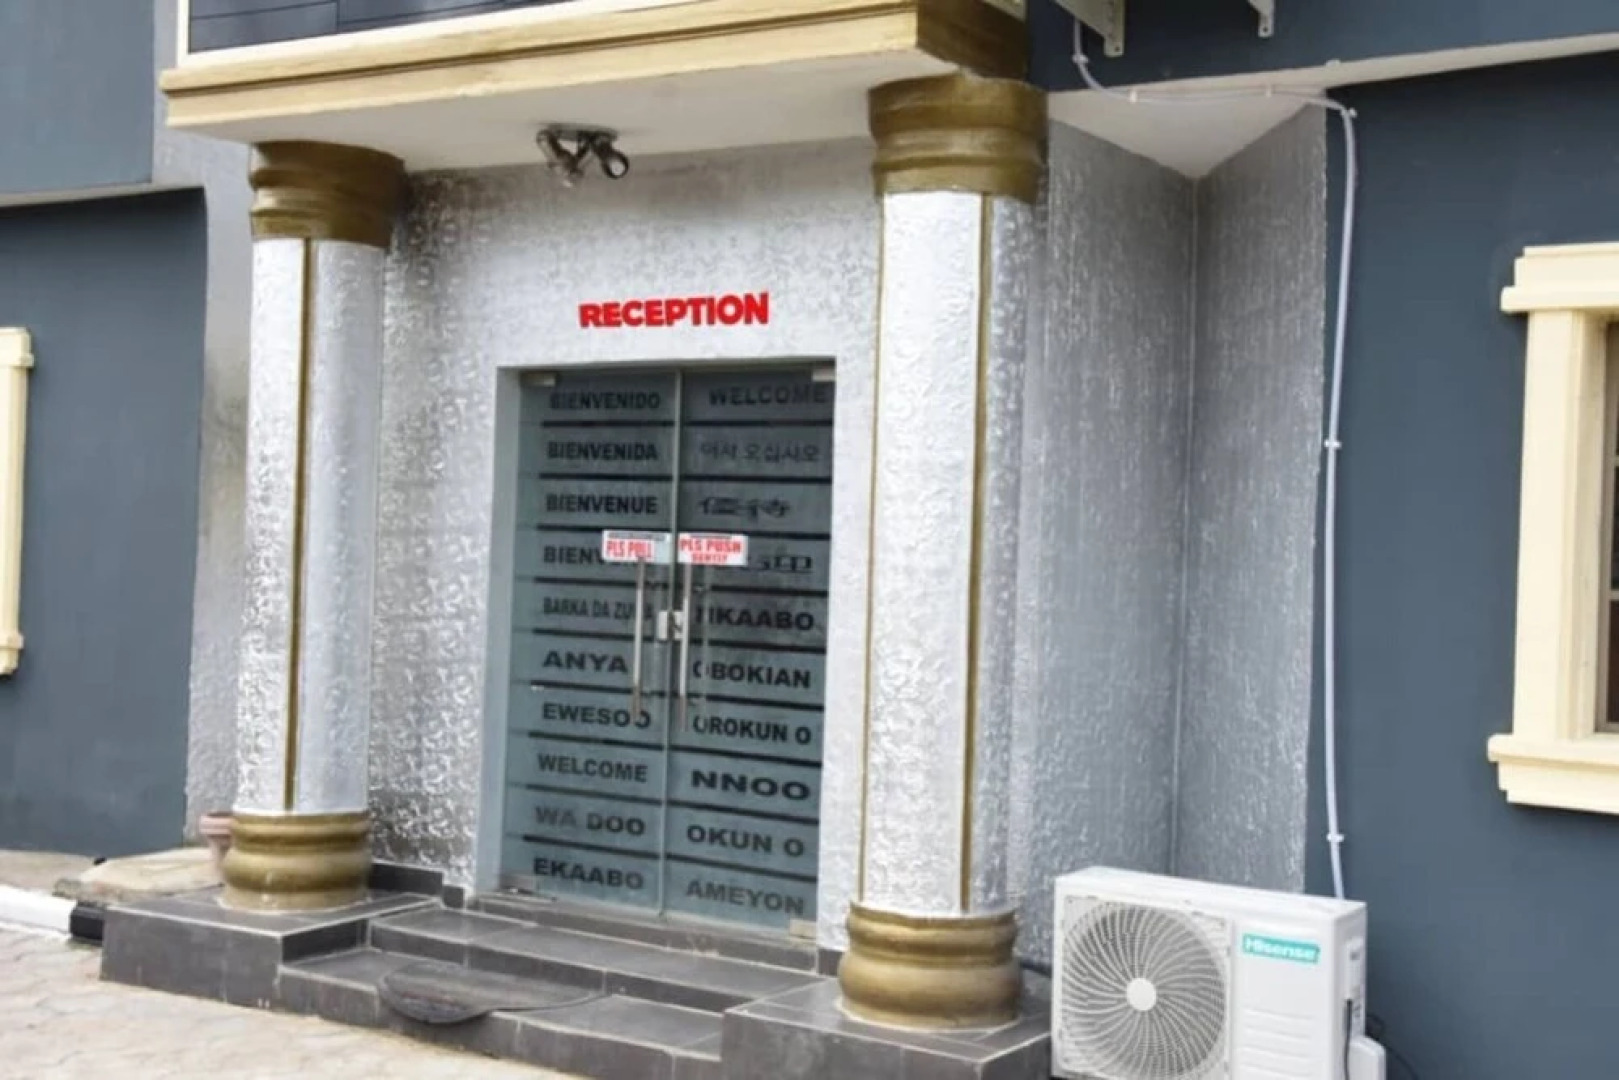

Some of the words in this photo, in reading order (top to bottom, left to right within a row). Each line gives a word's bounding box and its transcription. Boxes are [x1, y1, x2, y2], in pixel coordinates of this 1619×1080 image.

[579, 292, 769, 328] RECEPTION
[548, 391, 660, 410] BIENVENIDO
[709, 383, 828, 406] WELCOME
[547, 441, 658, 461] BIENVENIDA
[546, 494, 657, 514] BIENVENUE
[592, 599, 610, 618] DA
[542, 650, 628, 674] ANYA
[795, 727, 812, 745] O
[537, 753, 648, 783] WELCOME
[691, 770, 811, 800] NNOO
[535, 806, 577, 828] WA
[586, 812, 645, 836] DOO
[687, 824, 773, 853] OKUN
[783, 838, 805, 857] O
[533, 857, 644, 890] EKAABO
[686, 880, 804, 915] AMEYON
[1245, 937, 1317, 961] Hisense
